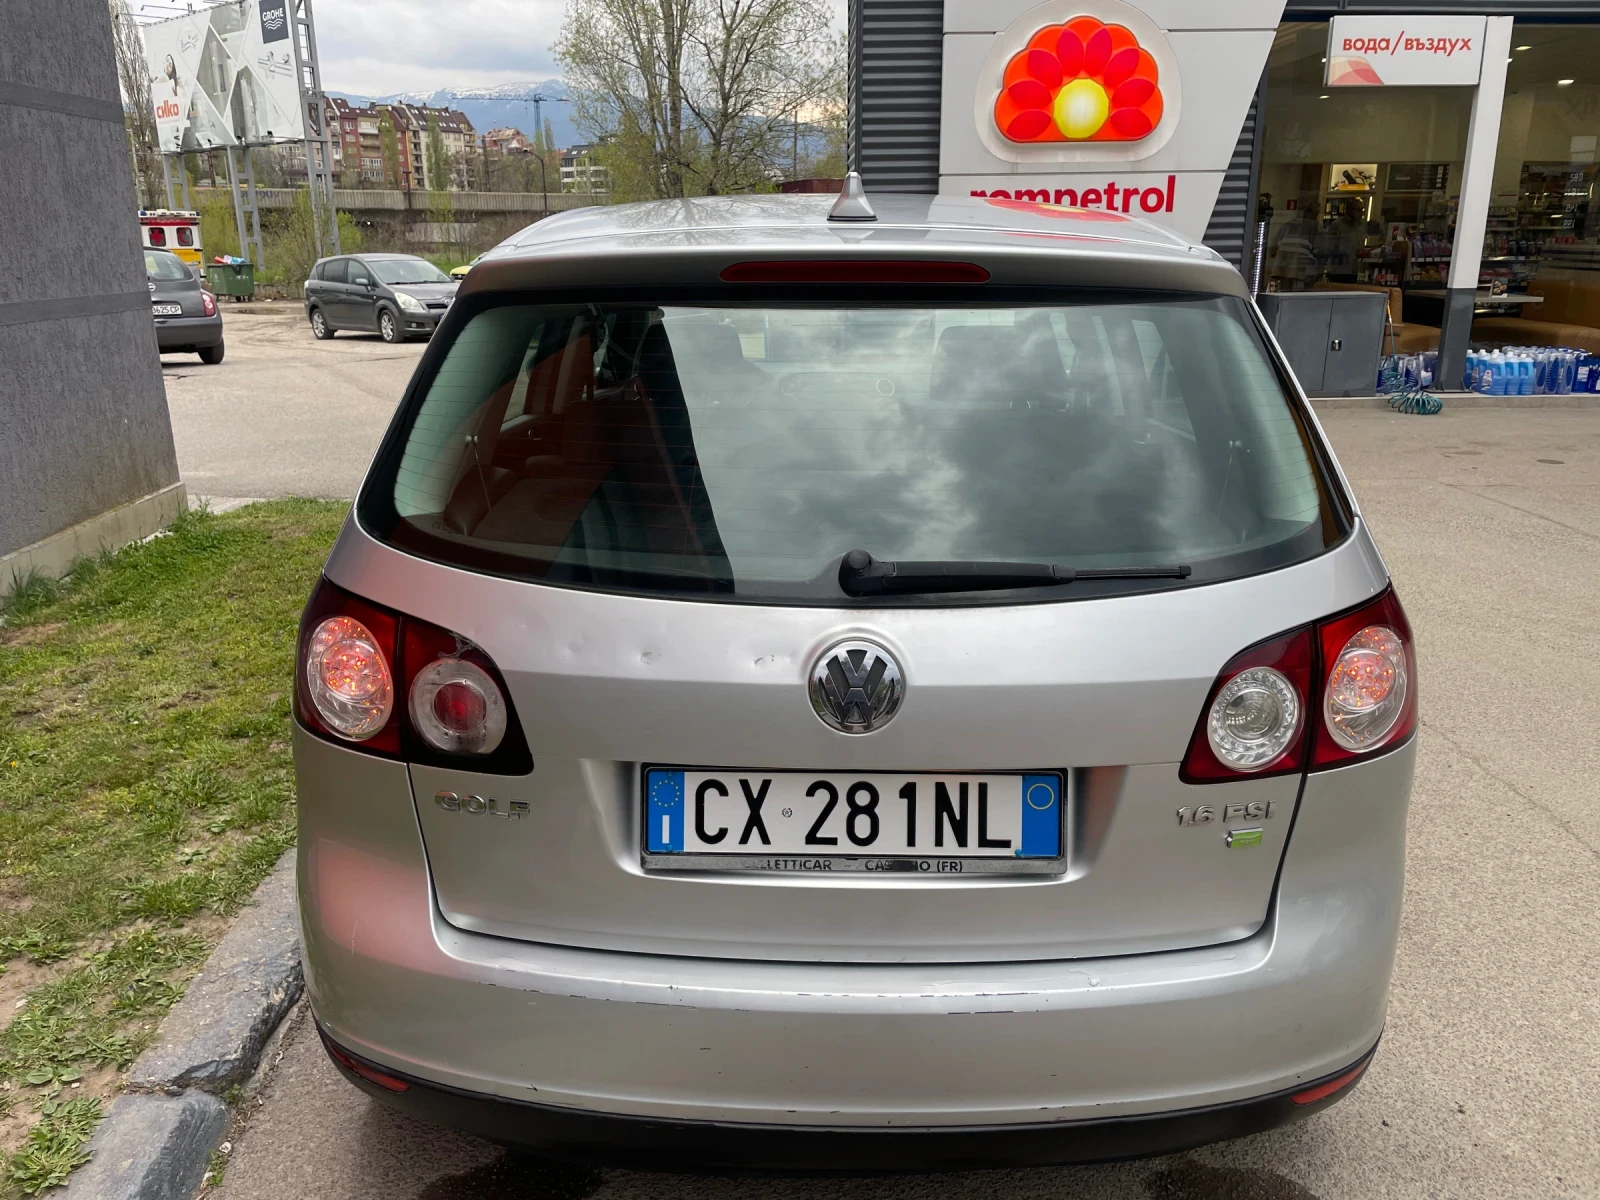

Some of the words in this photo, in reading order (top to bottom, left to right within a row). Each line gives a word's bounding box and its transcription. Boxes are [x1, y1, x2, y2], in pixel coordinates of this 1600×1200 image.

[262, 7, 284, 21] GROHE
[434, 790, 531, 820] GOLF
[1222, 799, 1277, 823] FSI
[936, 860, 963, 873] (FR)
